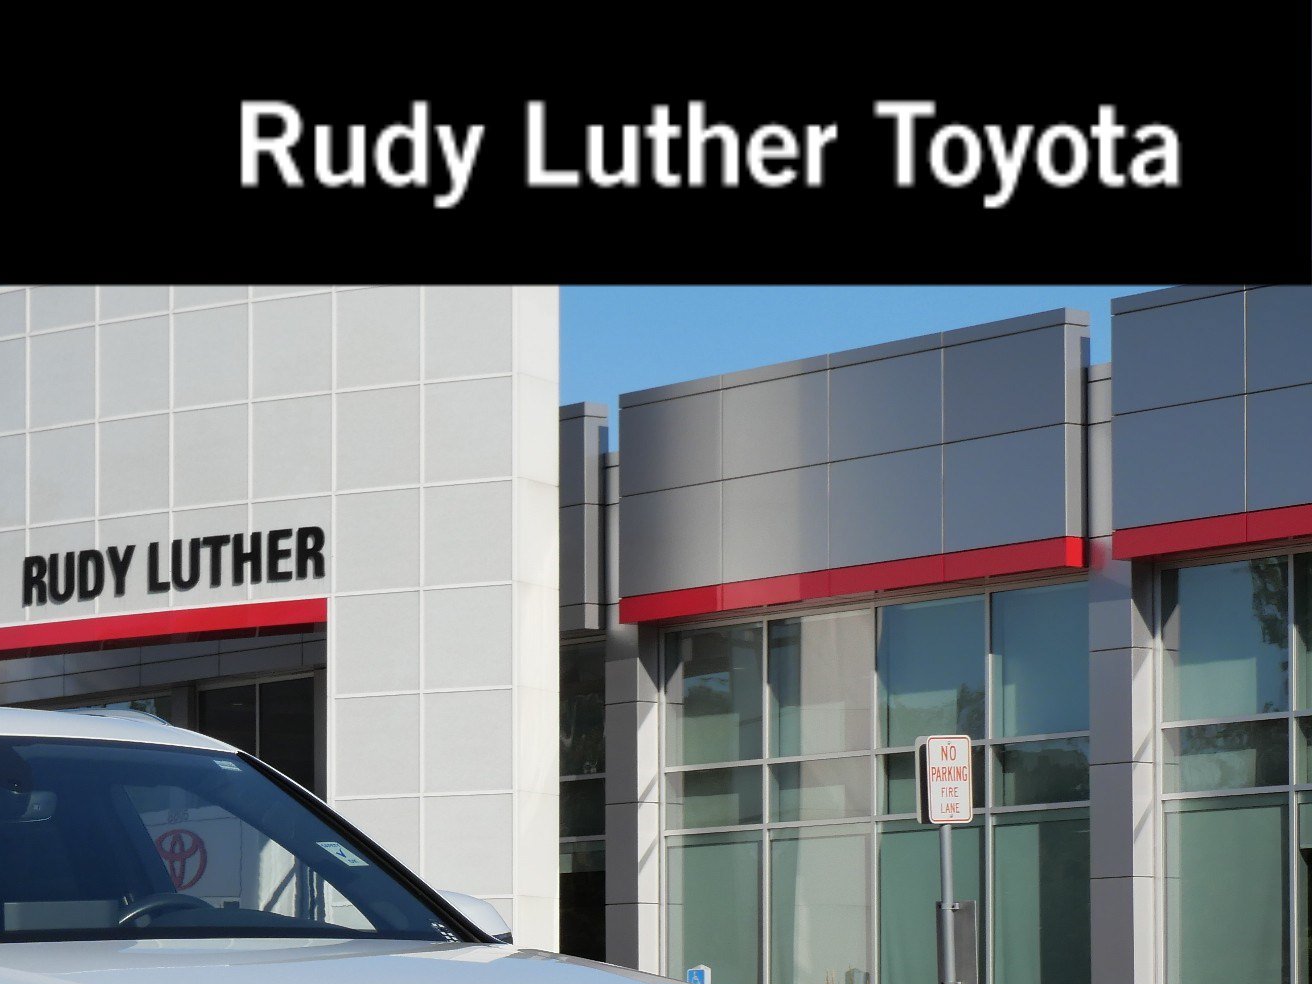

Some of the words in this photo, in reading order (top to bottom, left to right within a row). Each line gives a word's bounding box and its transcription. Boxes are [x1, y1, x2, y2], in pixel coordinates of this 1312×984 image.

[22, 545, 136, 608] RUDY
[147, 526, 326, 594] LUTHER
[941, 745, 956, 761] NO
[931, 766, 968, 782] PARKING
[941, 787, 959, 797] FIRE
[941, 803, 960, 814] LANE
